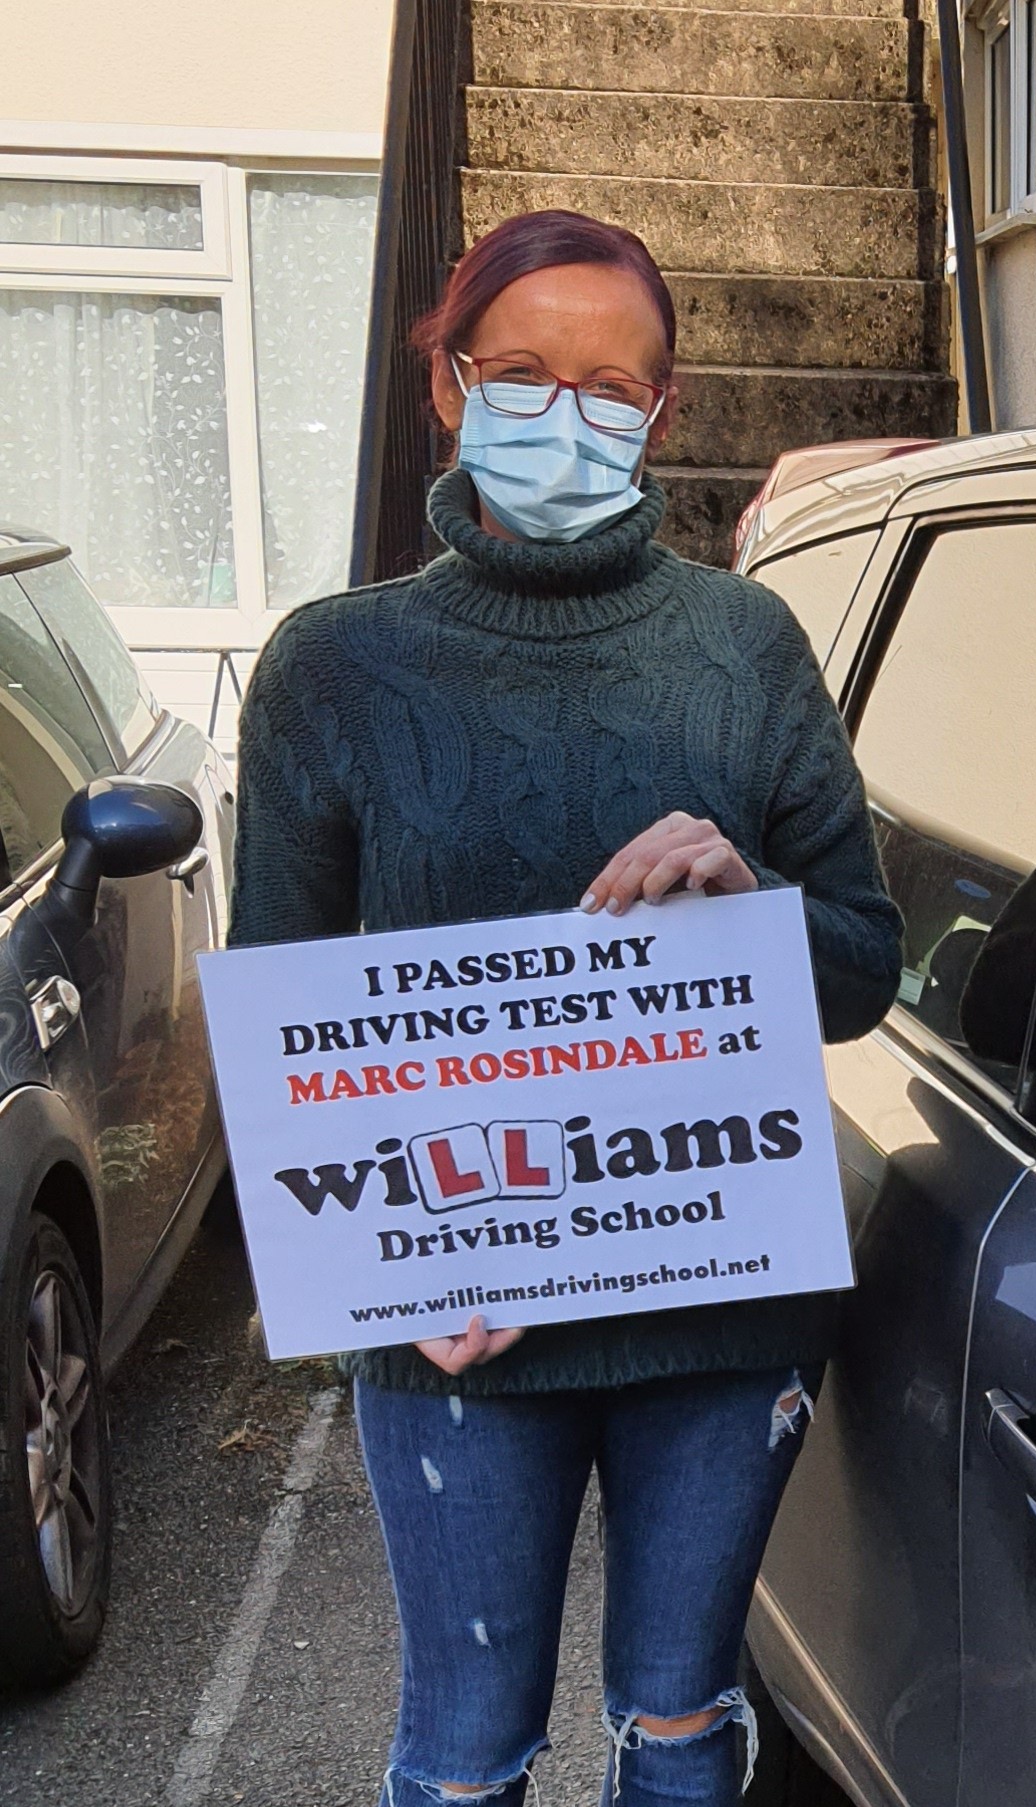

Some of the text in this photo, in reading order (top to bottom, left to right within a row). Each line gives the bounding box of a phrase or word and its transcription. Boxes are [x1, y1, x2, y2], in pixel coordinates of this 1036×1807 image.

[365, 936, 657, 996] I PASSED MY
[280, 975, 754, 1056] DRIVING TEST WITH
[286, 1026, 761, 1105] MARC ROSINDALE at
[377, 1192, 725, 1262] Driving School
[350, 1255, 771, 1323] www.williamsdrivingschool.net
